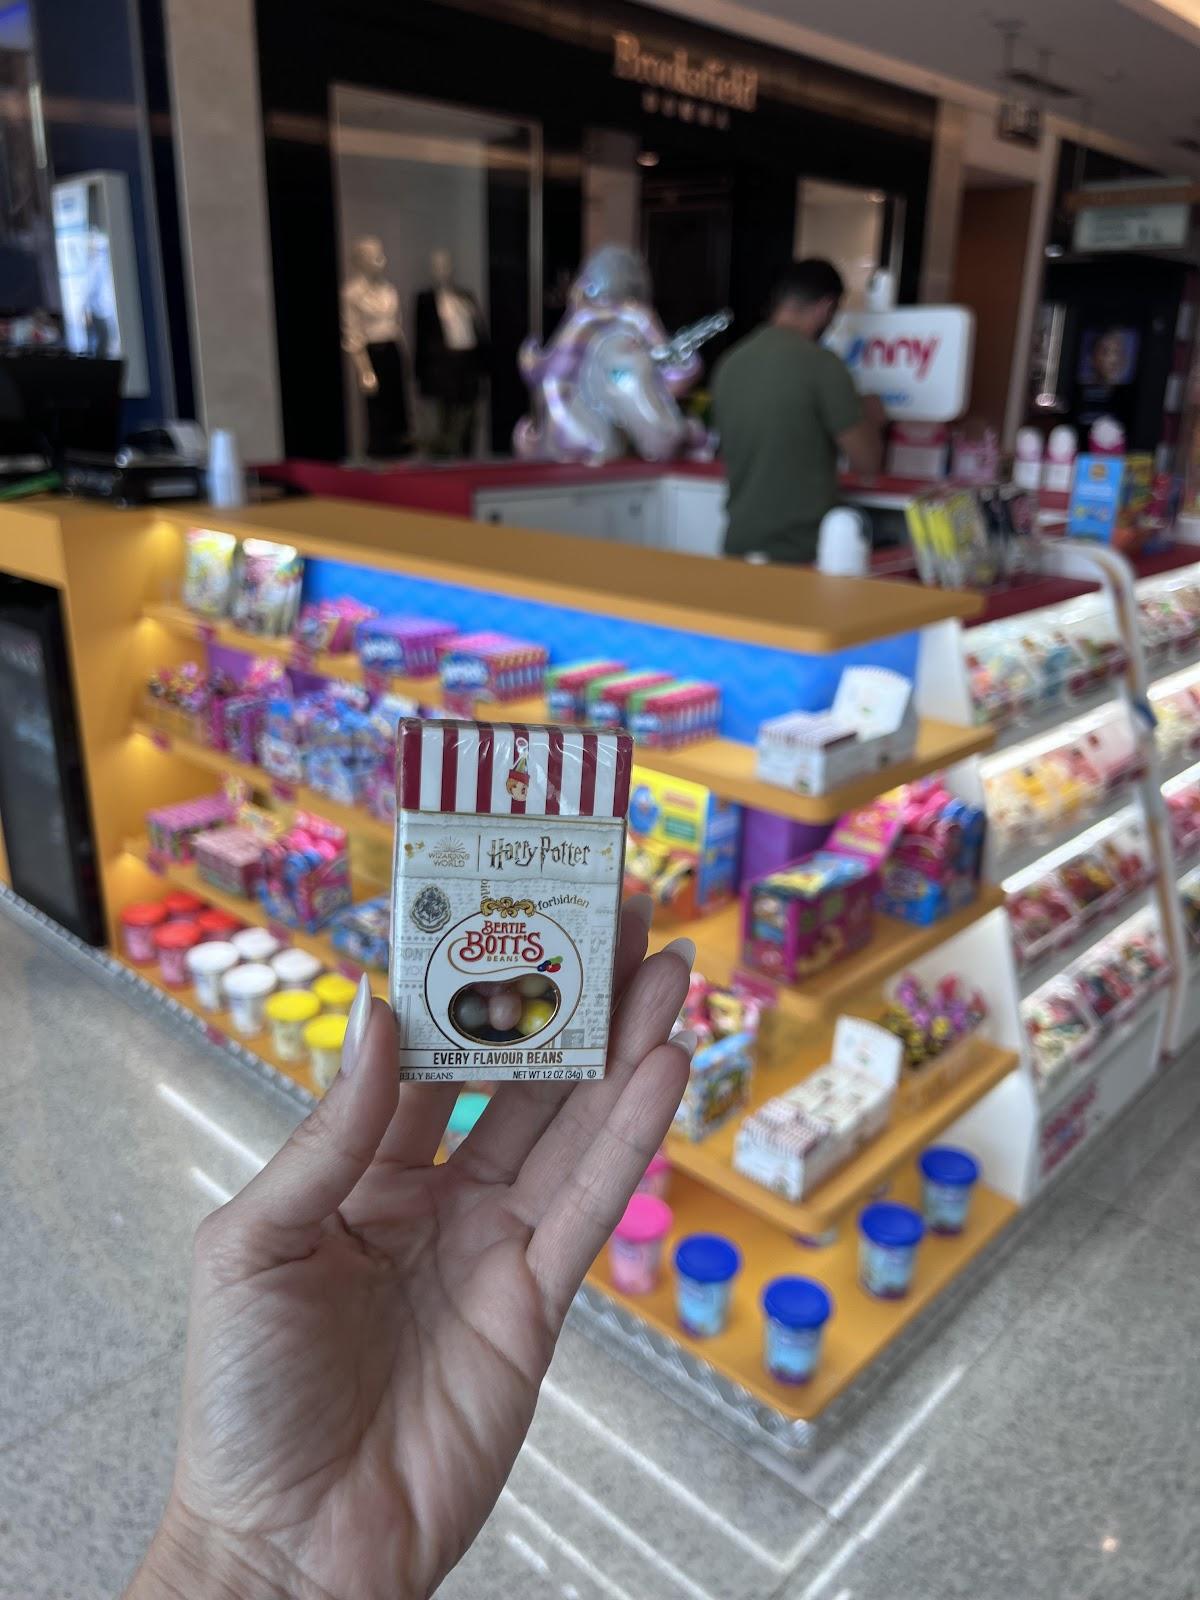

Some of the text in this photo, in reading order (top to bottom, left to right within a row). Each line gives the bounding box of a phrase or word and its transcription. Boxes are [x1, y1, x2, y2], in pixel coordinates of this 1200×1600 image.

[487, 836, 590, 872] Harry Potter
[433, 860, 465, 868] WORLD
[537, 894, 590, 911] forbidden
[482, 920, 526, 935] BERTIE
[459, 931, 544, 962] BOTT'S
[433, 1051, 563, 1065] EVERY FLAVOUR BEANS
[425, 1072, 454, 1080] BEANS
[513, 1070, 528, 1079] NET
[528, 1070, 540, 1079] WT
[542, 1070, 553, 1079] 1.2
[553, 1070, 564, 1079] OZ
[565, 1069, 583, 1080] (34g)
